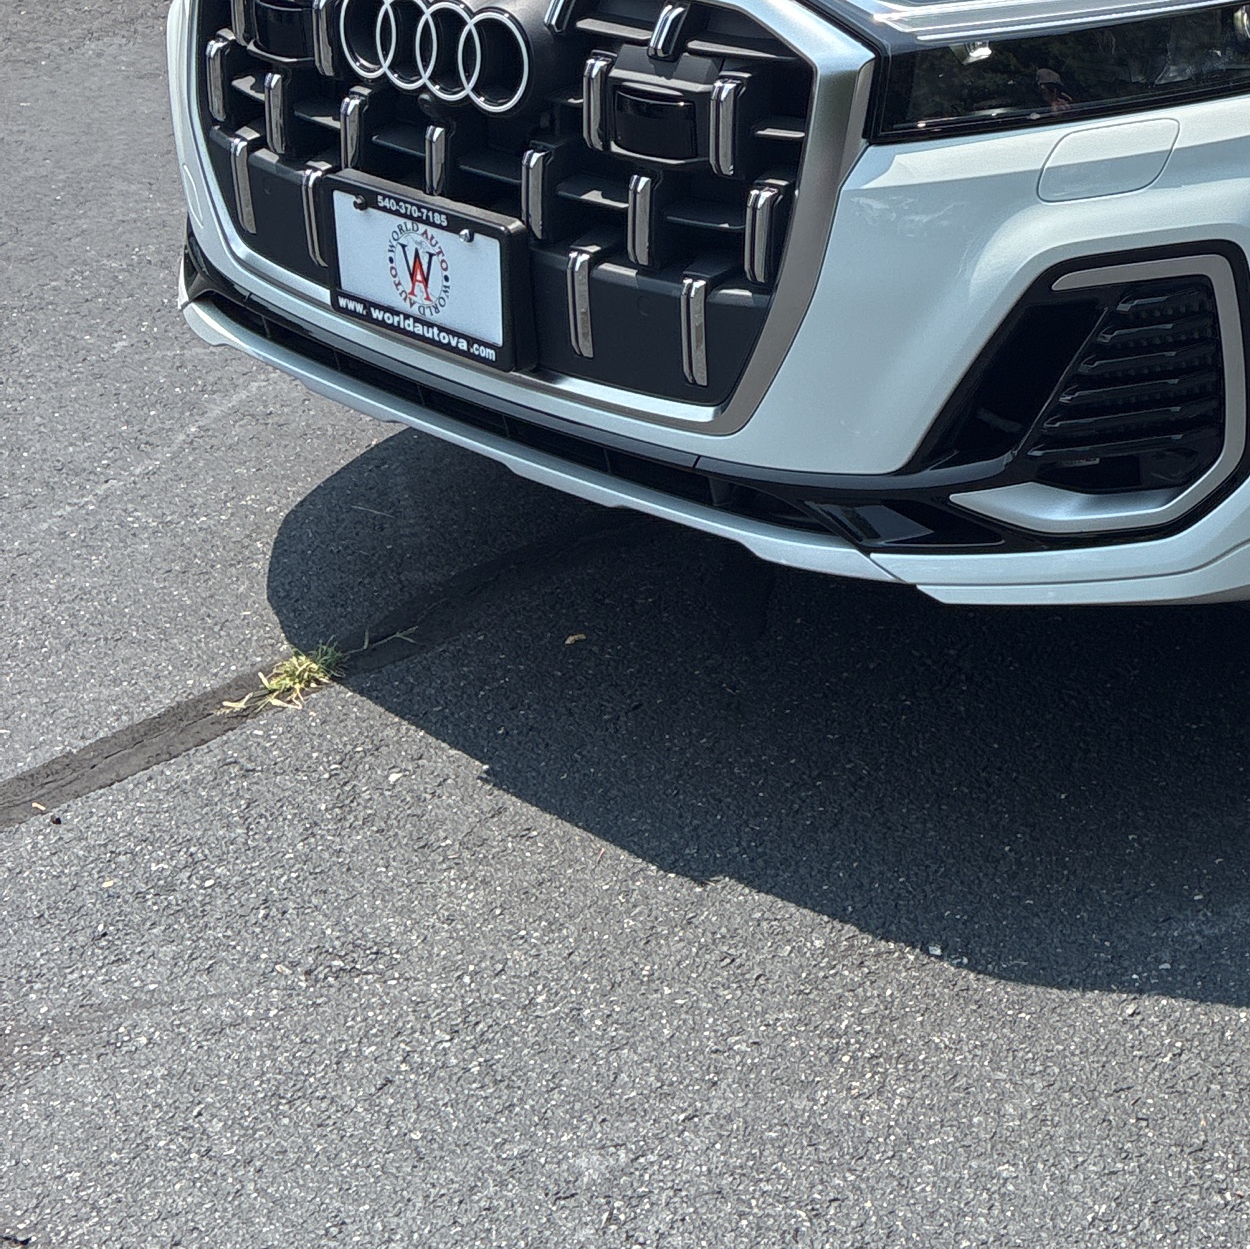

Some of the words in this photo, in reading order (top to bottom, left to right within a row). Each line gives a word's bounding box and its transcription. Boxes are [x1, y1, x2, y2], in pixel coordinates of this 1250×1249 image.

[377, 195, 448, 227] 540-370-7185
[388, 221, 419, 253] WORLD
[421, 228, 449, 272] AUTO
[389, 265, 416, 308] AUTO
[418, 284, 451, 317] WORLD
[370, 306, 468, 351] worldautova
